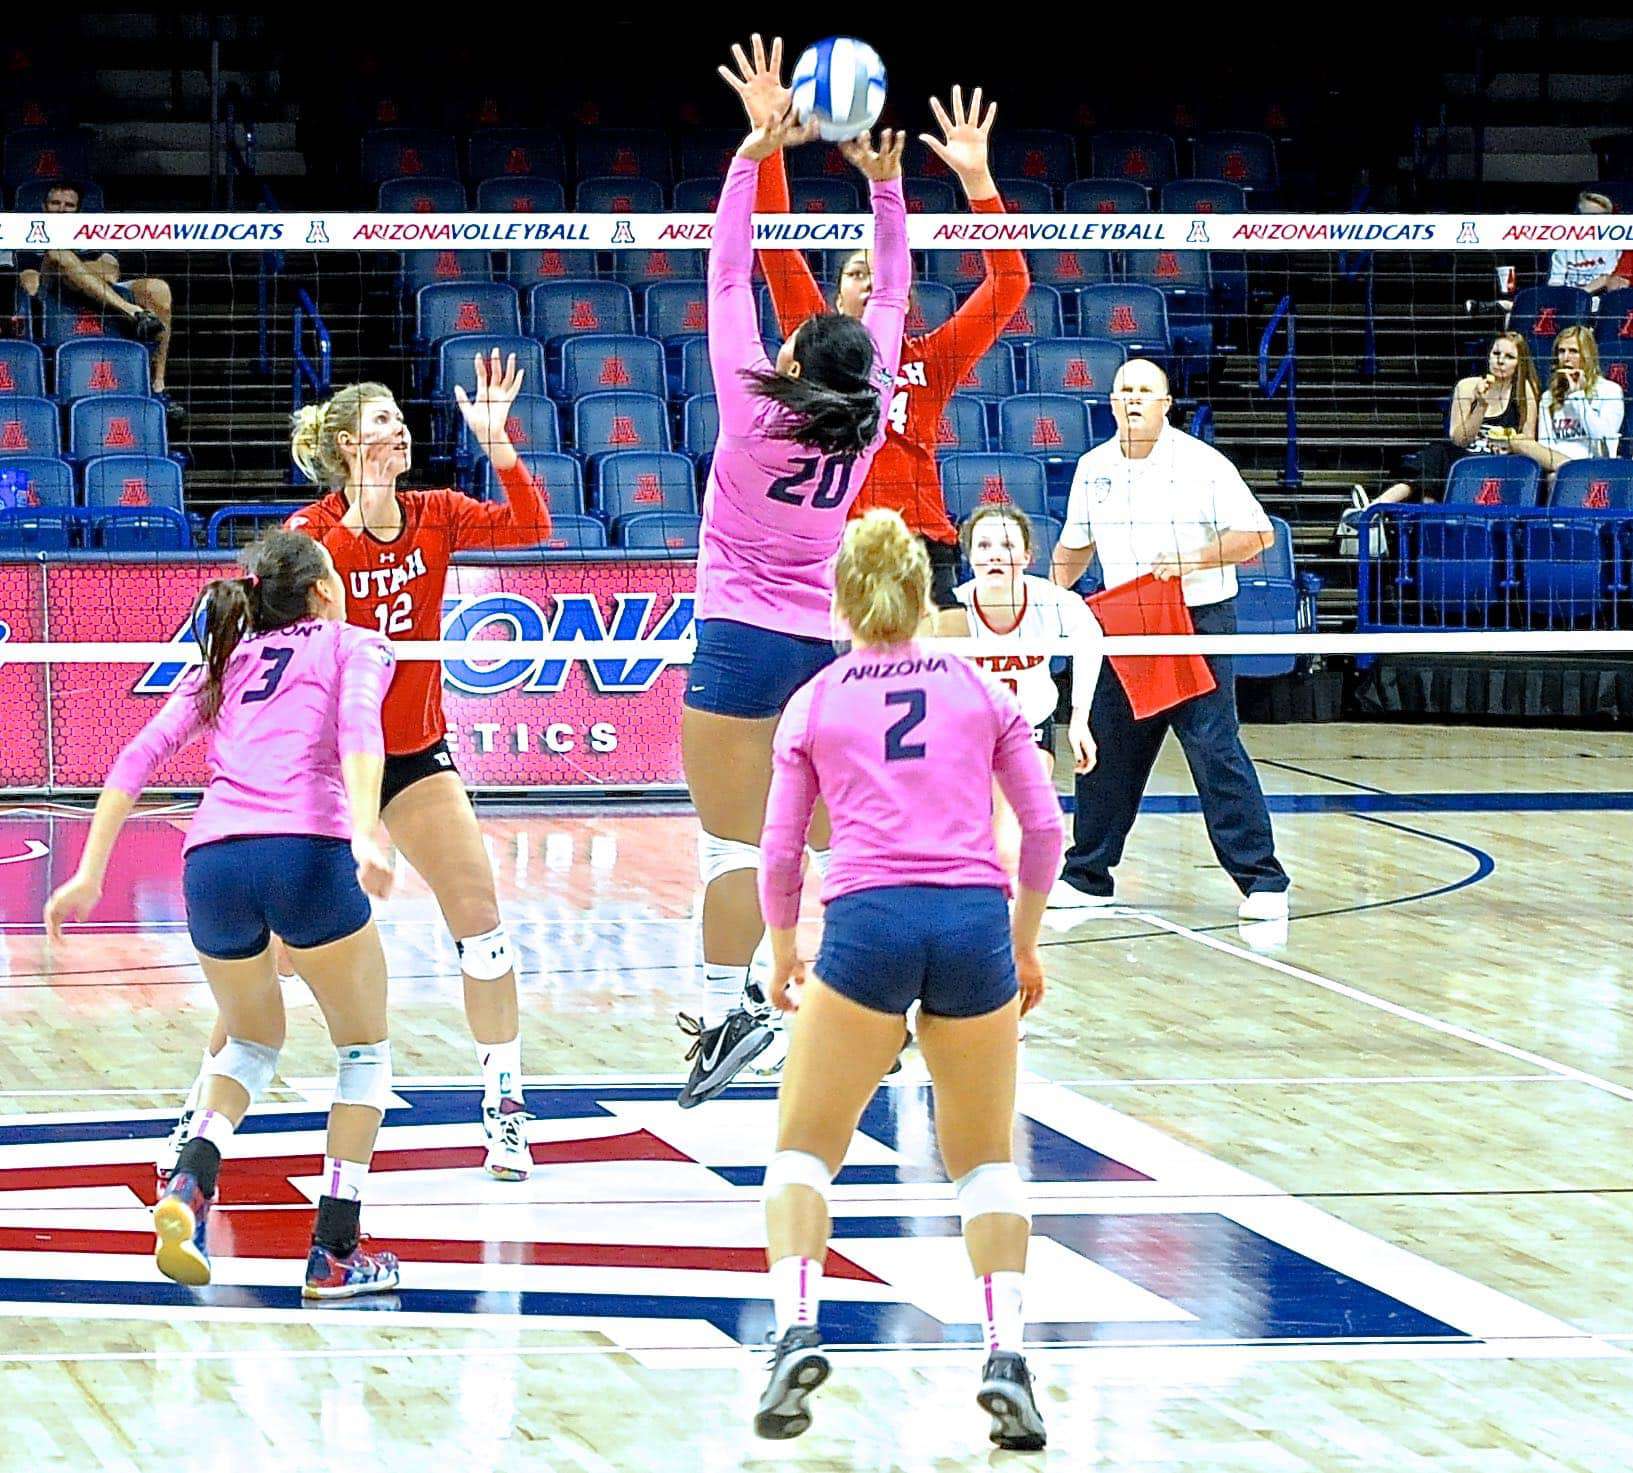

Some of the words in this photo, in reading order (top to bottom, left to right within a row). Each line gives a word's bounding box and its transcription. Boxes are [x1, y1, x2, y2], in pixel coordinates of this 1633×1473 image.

[765, 452, 856, 510] 20
[350, 548, 428, 599] UTAH
[374, 592, 414, 636] 12
[241, 646, 295, 705] 3
[841, 656, 948, 685] ARIZONA
[884, 687, 927, 762] 2
